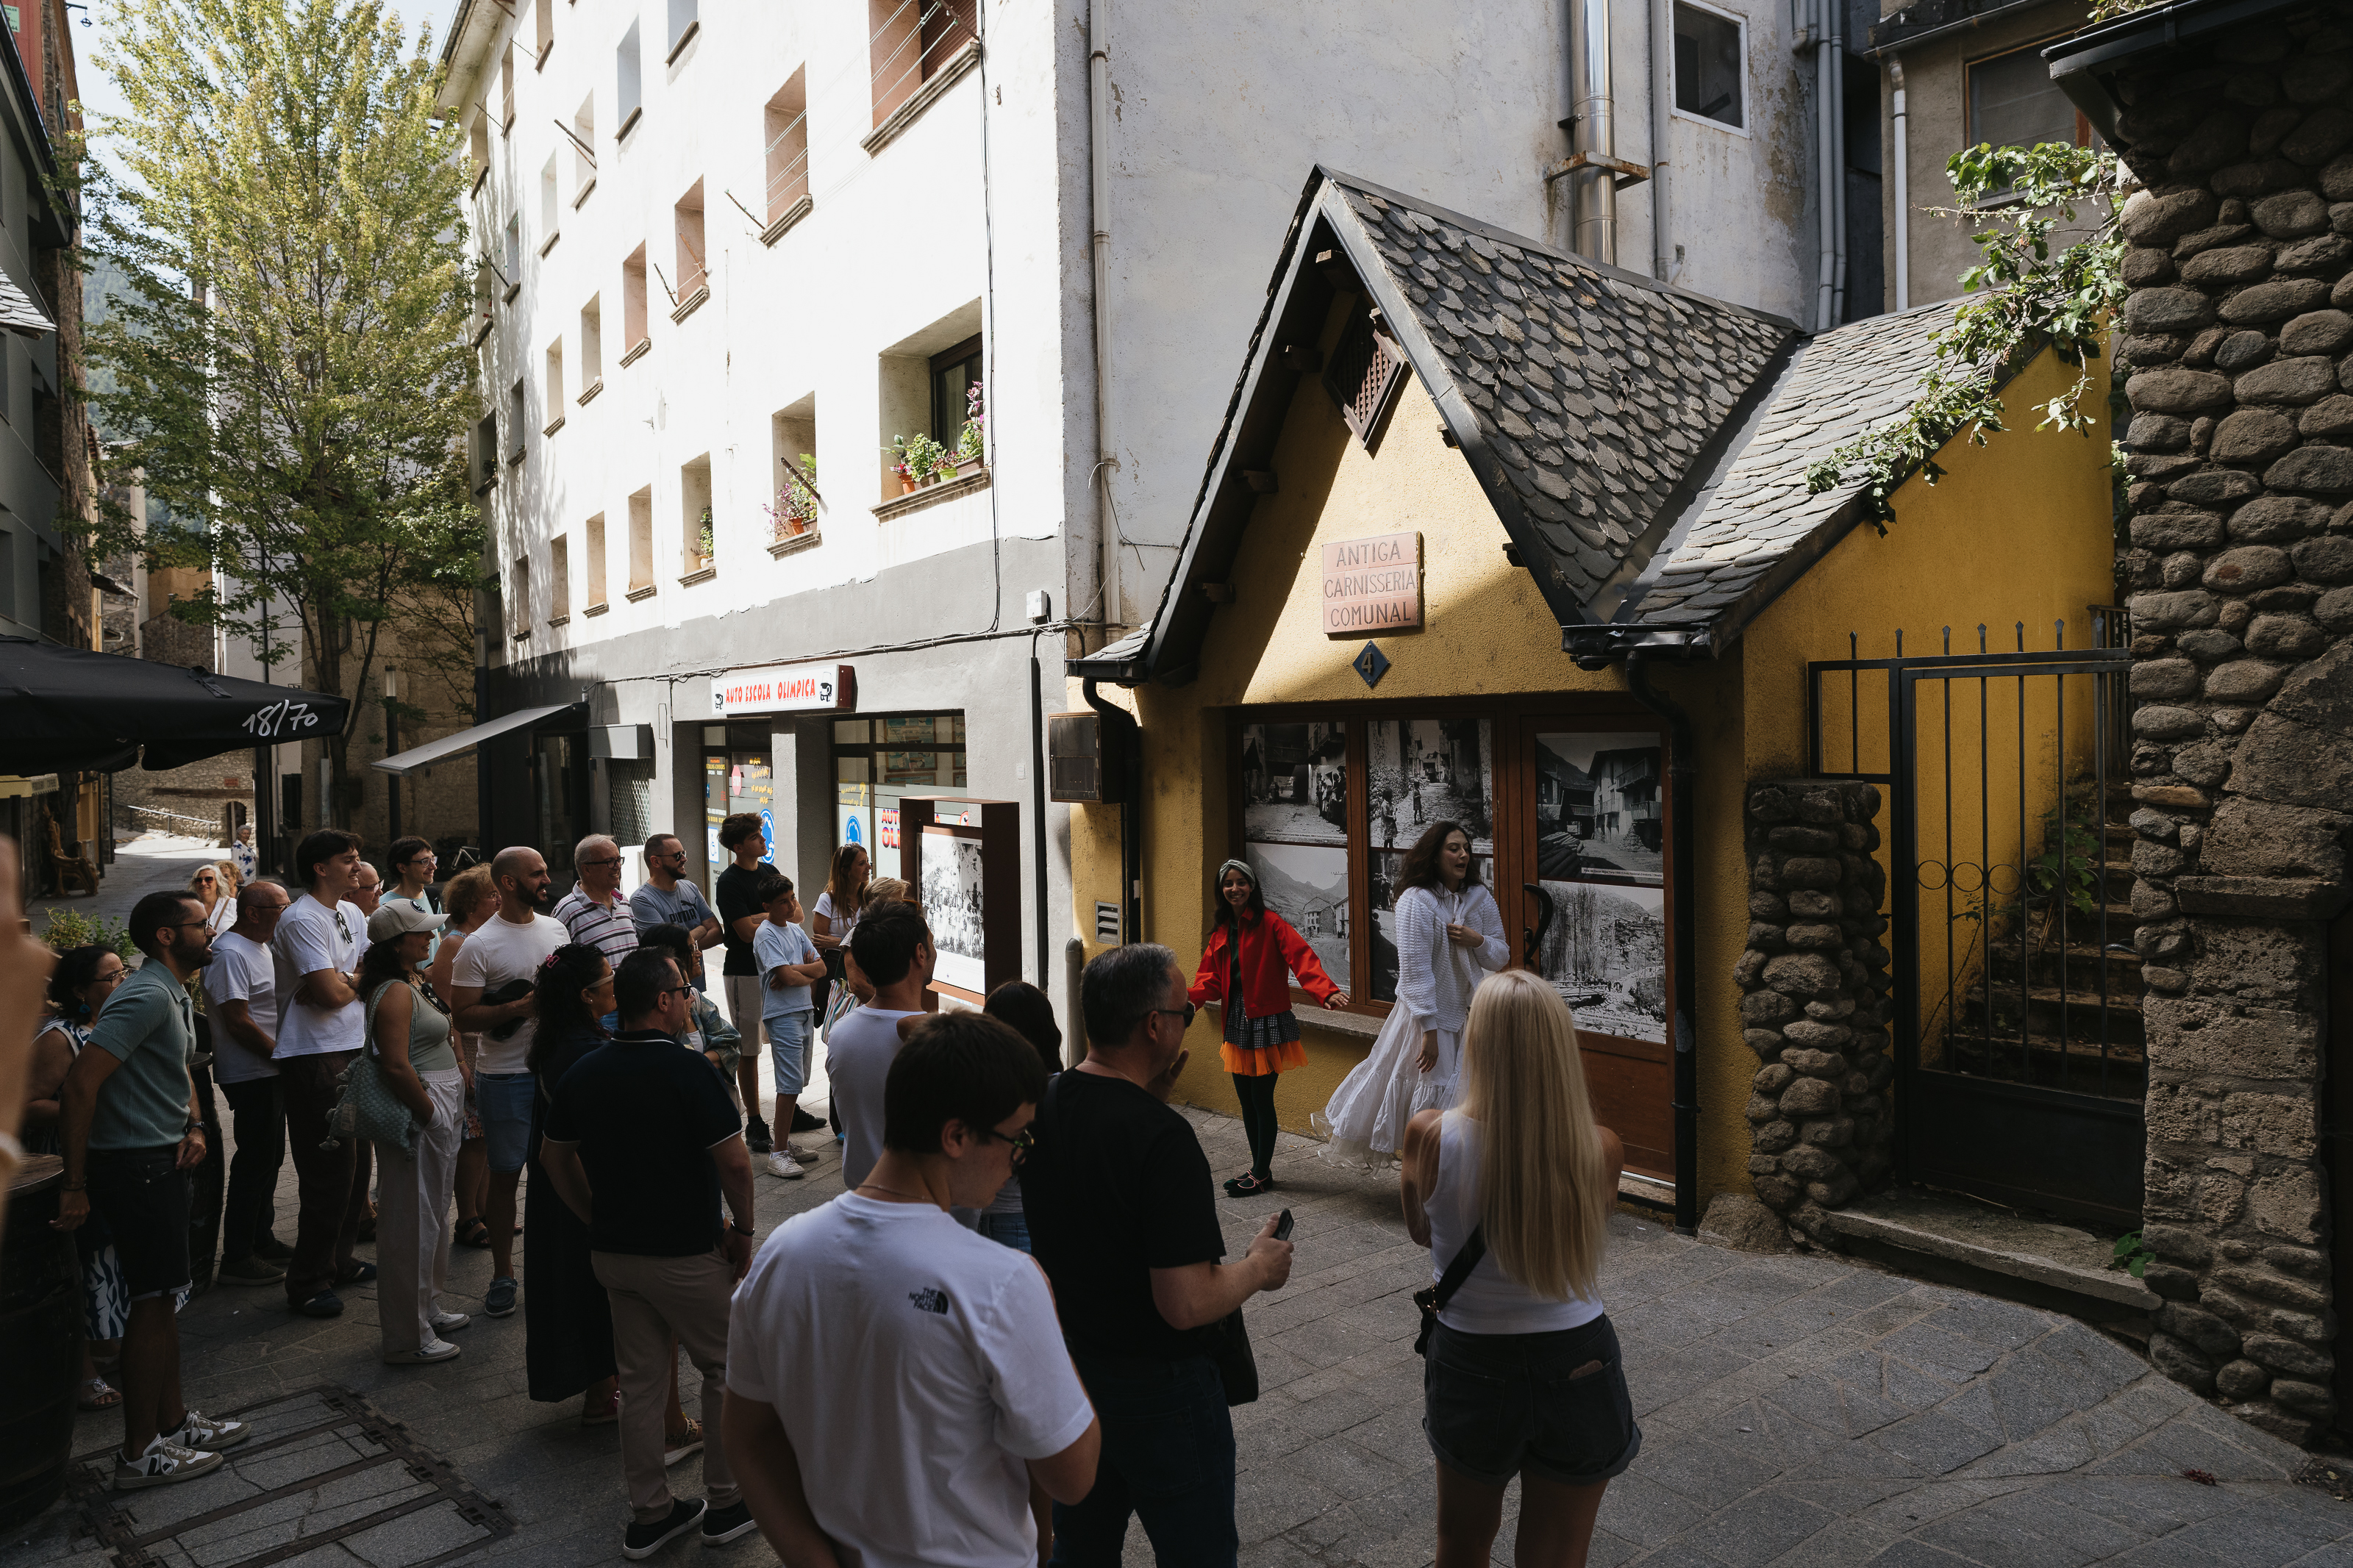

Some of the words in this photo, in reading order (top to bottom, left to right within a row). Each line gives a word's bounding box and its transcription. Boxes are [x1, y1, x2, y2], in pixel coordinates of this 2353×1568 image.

[1336, 540, 1402, 568] ANTIGA
[1324, 569, 1416, 598] CARNISSERIA
[1330, 601, 1411, 627] COMUNAL
[1361, 652, 1372, 673] 4
[726, 686, 743, 704] AUTO
[746, 684, 771, 702] ESCOLA
[241, 699, 318, 737] 18/70
[732, 776, 741, 787] STOP
[882, 809, 901, 825] AUT
[668, 908, 697, 923] PUMA
[908, 1292, 935, 1306] NORTH
[923, 1287, 936, 1297] THE
[913, 1300, 933, 1312] FACE
